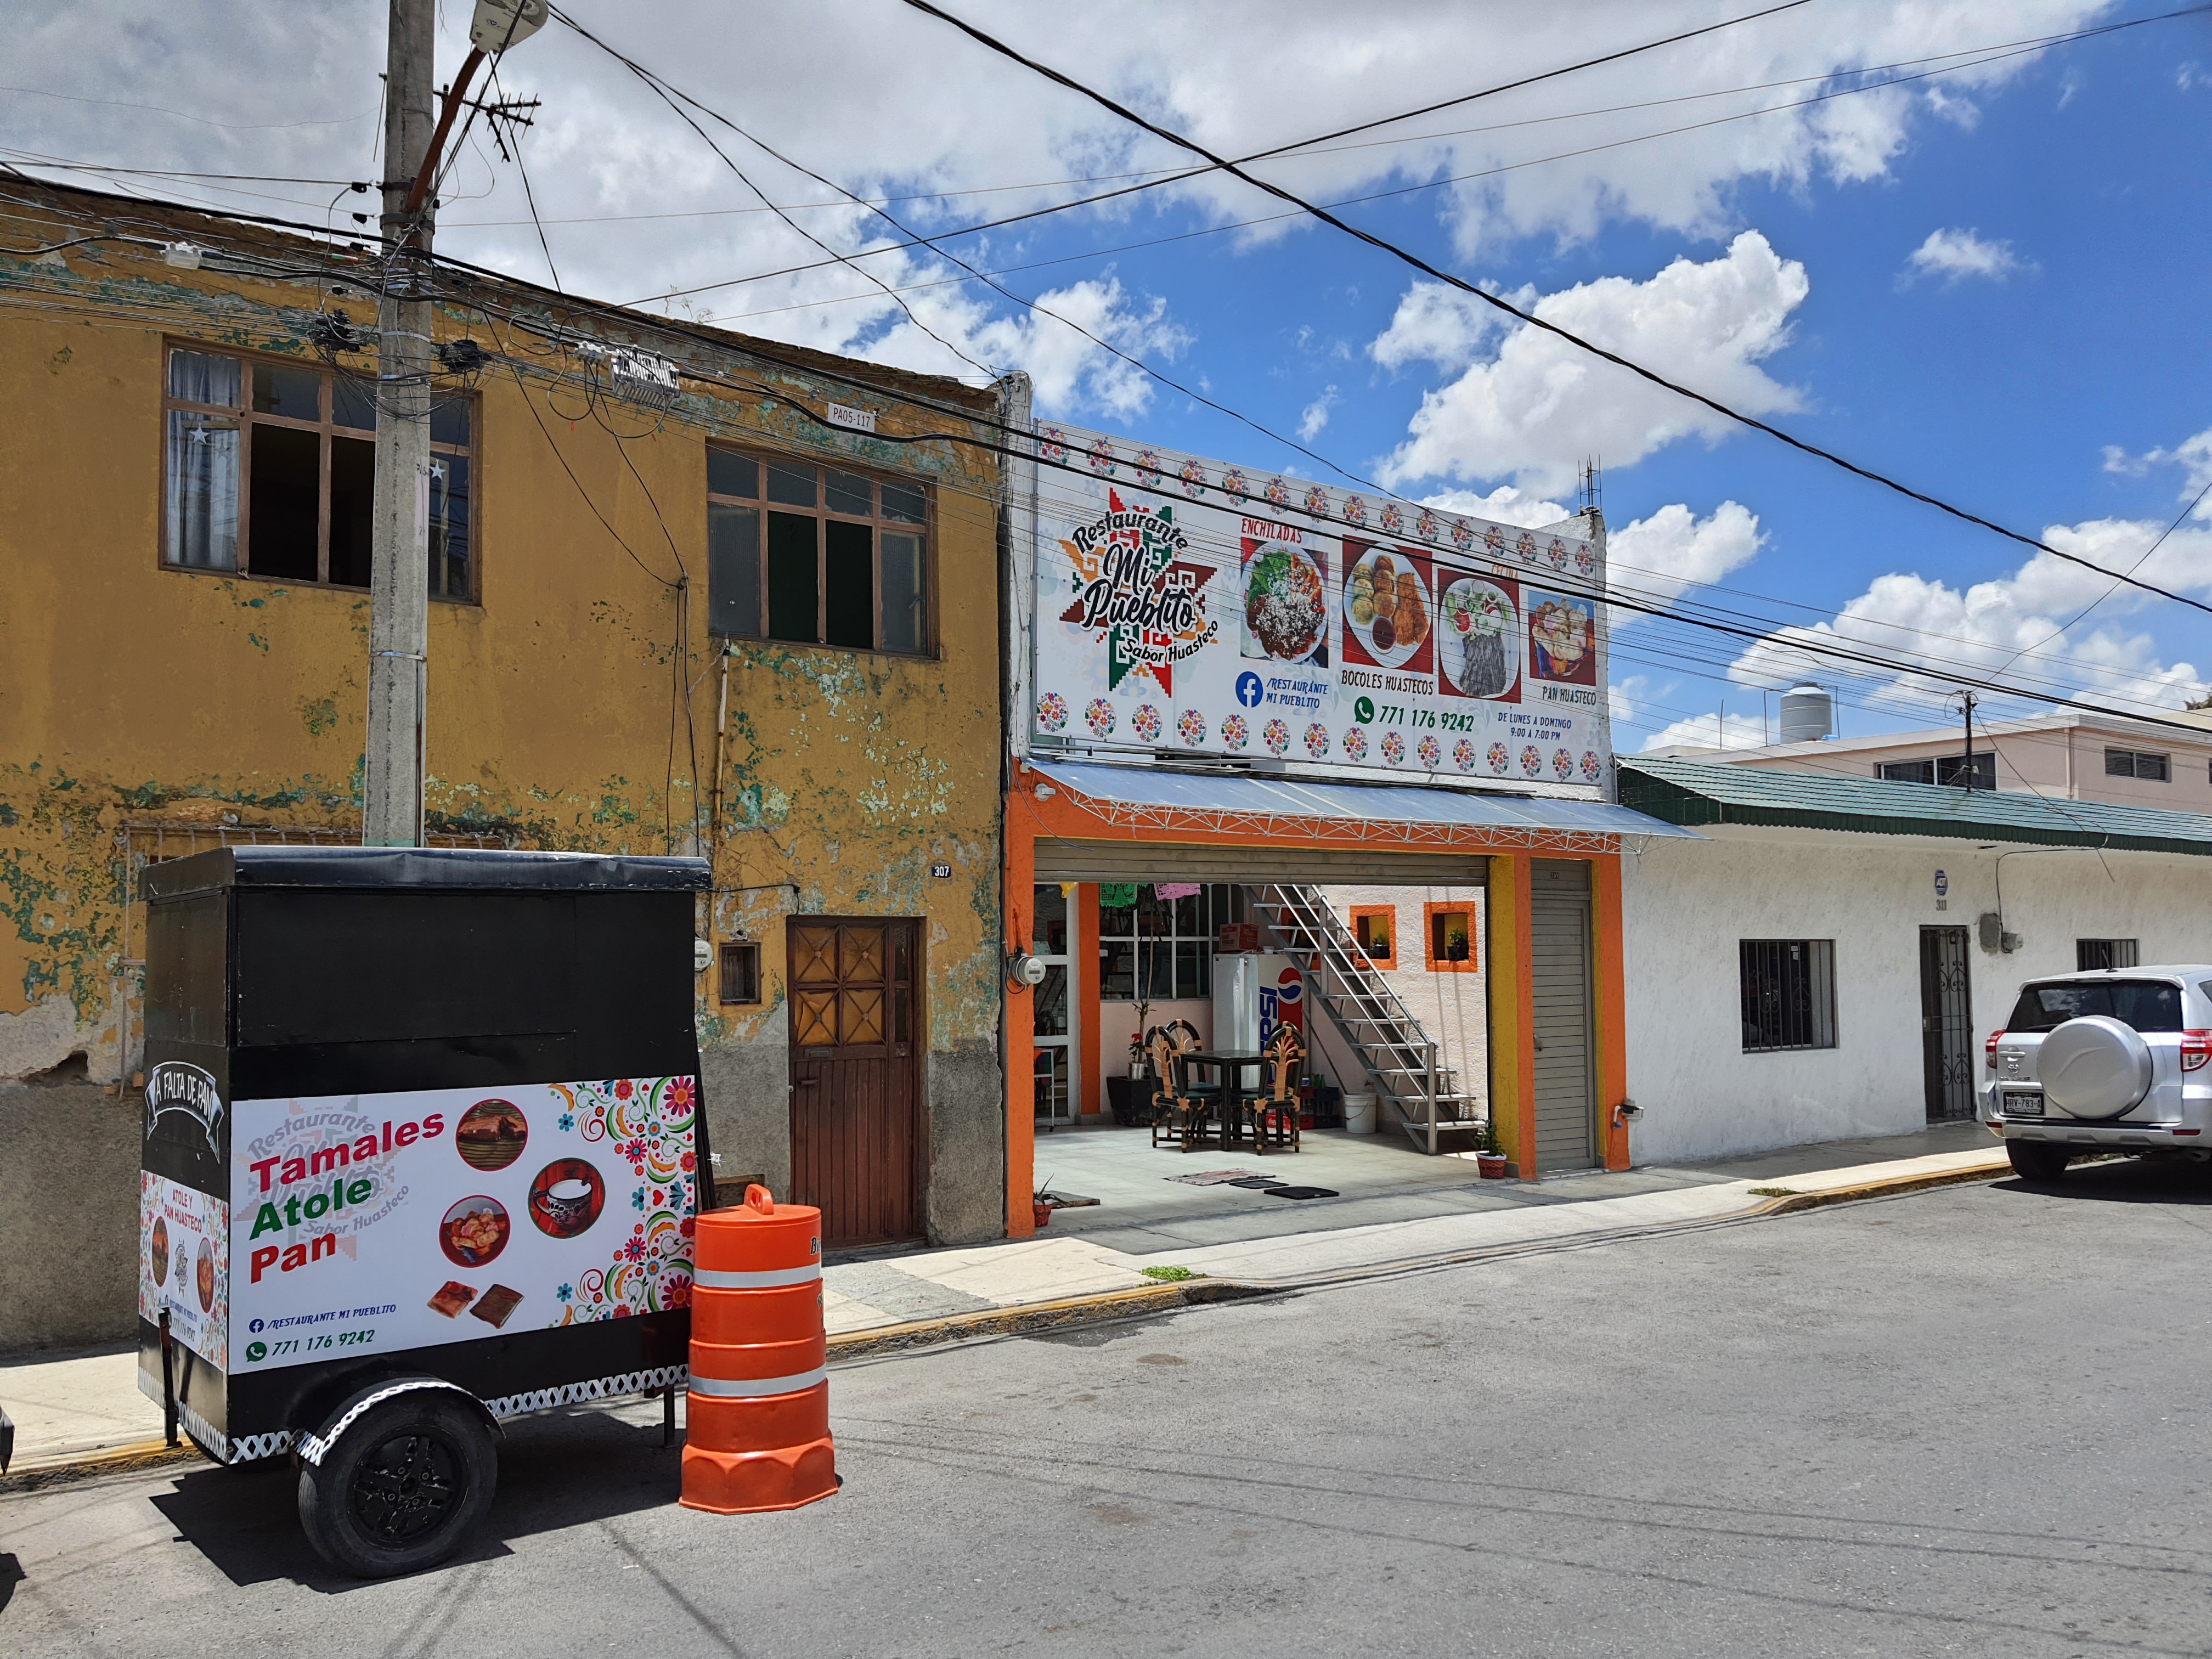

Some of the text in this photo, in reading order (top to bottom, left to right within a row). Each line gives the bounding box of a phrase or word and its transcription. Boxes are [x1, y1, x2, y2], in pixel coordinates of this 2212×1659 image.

[833, 407, 871, 428] PA05-117
[1072, 511, 1188, 555] Restaurante
[1241, 518, 1303, 544] ENCHILADAS
[1103, 543, 1154, 596] Mi
[1081, 579, 1196, 632] Pueblito
[1122, 620, 1218, 662] Sabor Huasteco
[1341, 669, 1434, 696] BOCOLES HUASTECOS
[1542, 686, 1596, 706] PAN HUASTECO
[1266, 692, 1320, 709] MI PUEBLITO
[1379, 705, 1475, 732] 771 176 9242
[1498, 712, 1572, 729] DE LUNES A DOMINGO
[1510, 727, 1561, 741] 9:00 A 7:00 PM
[934, 866, 949, 877] 307
[1936, 899, 1947, 911] 311
[156, 1070, 213, 1122] A FALTA DE PAN
[247, 1114, 376, 1160] Restaurante
[250, 1113, 444, 1193] Tamales
[172, 1189, 193, 1210] ATOLE Y
[249, 1178, 372, 1241] Atole
[303, 1186, 409, 1234] Sabor Huasteco
[165, 1203, 202, 1234] PAN HUASTECO
[251, 1233, 336, 1284] Pan
[267, 1304, 397, 1330] /RESTAURANTE MI PUEBLITO
[187, 1325, 195, 1342] 9242
[272, 1329, 375, 1356] 771 176 9242
